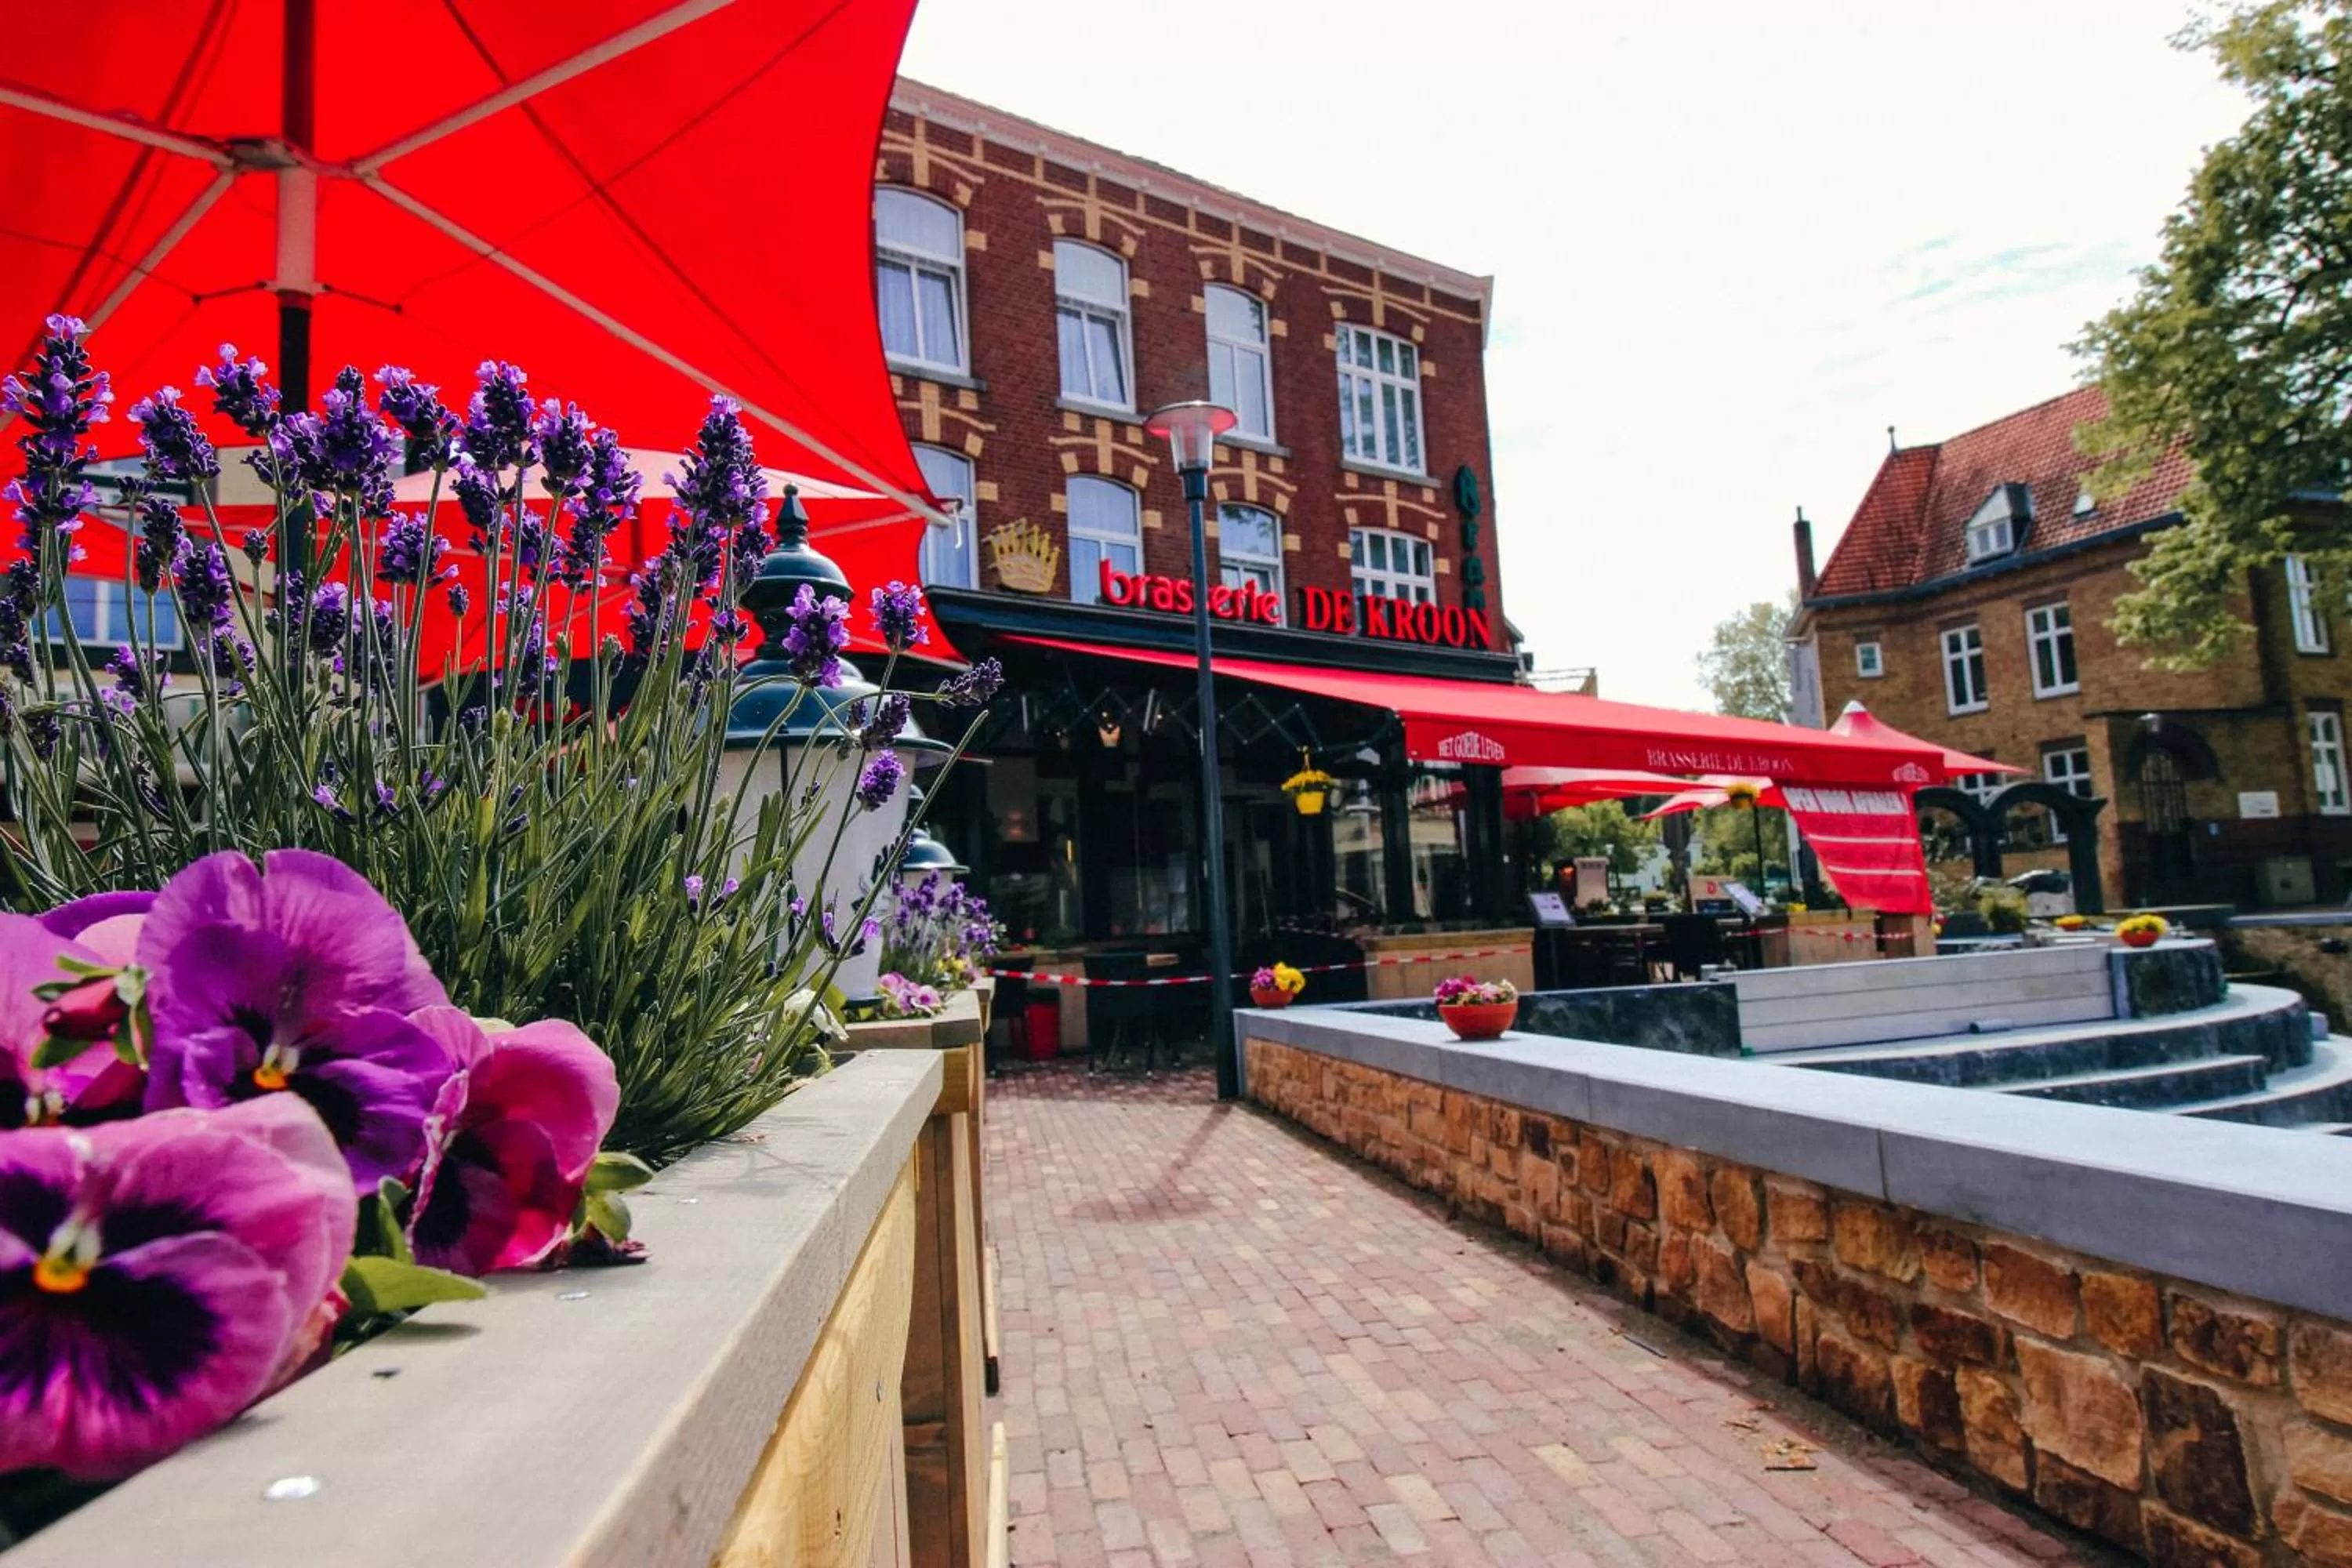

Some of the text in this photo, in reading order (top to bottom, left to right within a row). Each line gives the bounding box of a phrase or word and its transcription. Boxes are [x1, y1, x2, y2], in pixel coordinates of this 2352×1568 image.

[1099, 558, 1491, 648] braserie DE KROON
